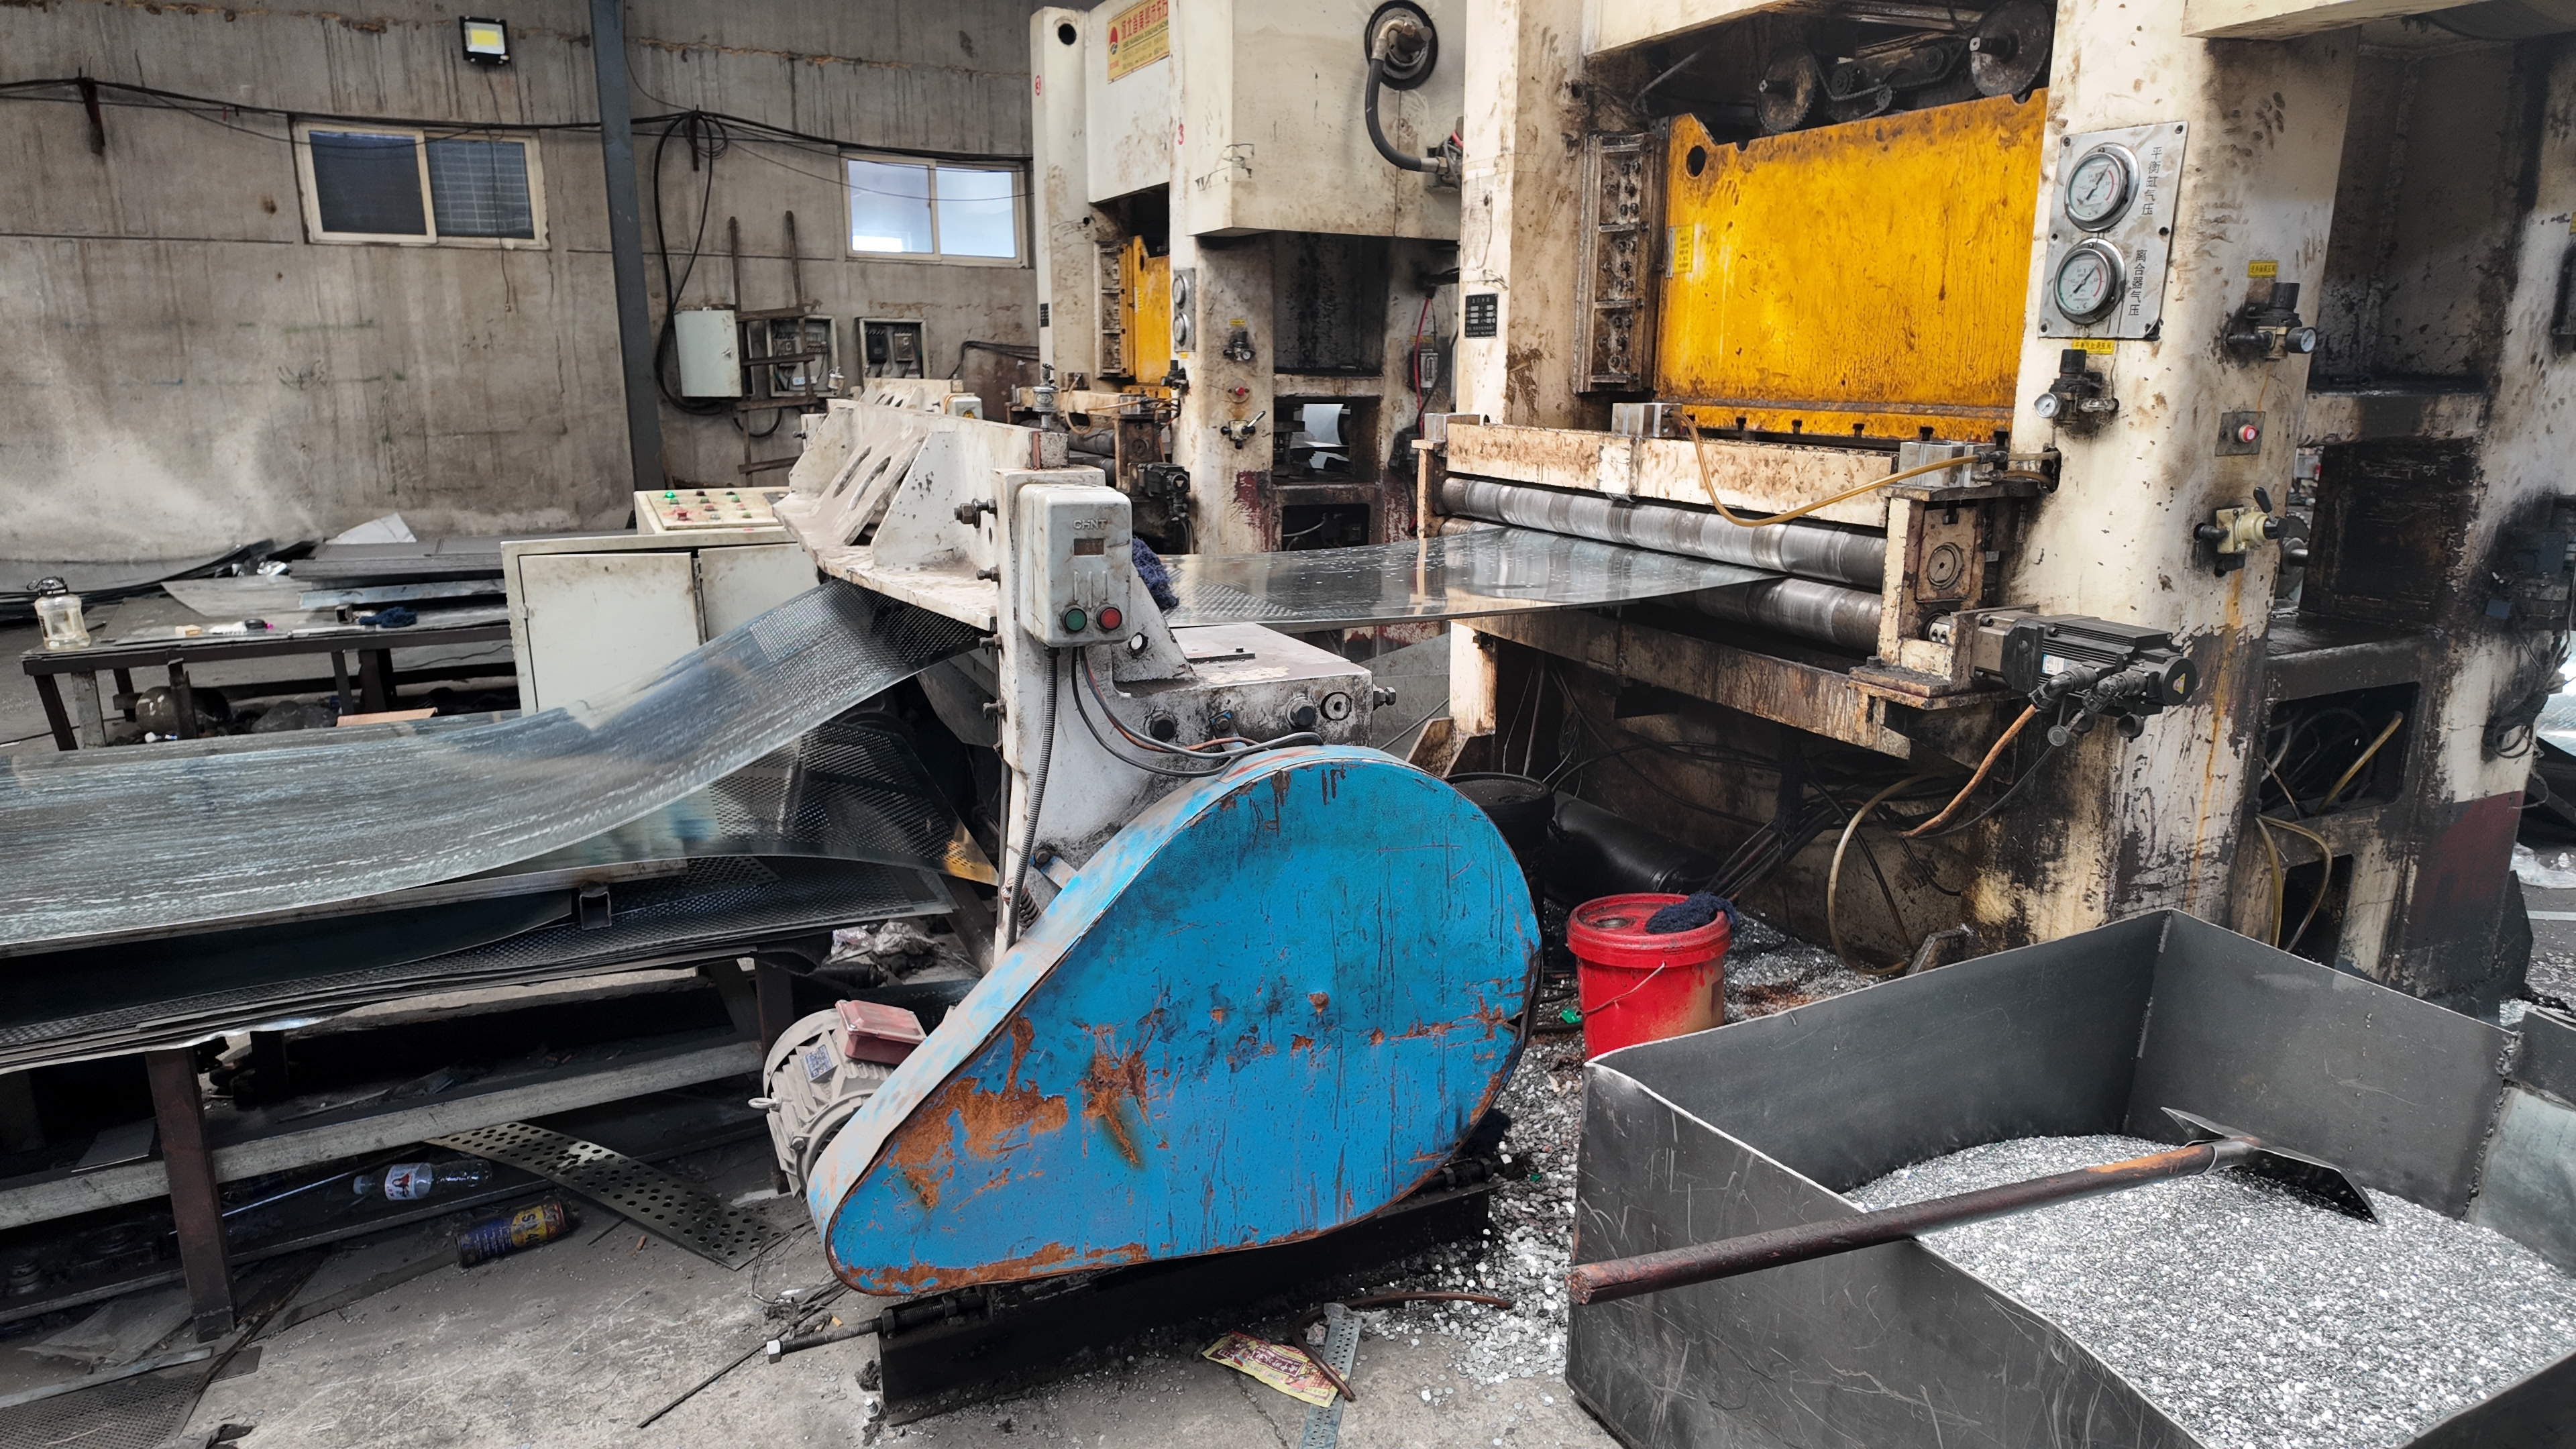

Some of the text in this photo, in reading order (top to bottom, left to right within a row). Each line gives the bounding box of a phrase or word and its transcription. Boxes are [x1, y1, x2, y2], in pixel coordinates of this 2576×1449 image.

[1177, 123, 1185, 146] 3
[2141, 146, 2162, 215] 平衡缸气压
[2128, 249, 2147, 317] 离合器气压
[1073, 519, 1107, 529] CHNT
